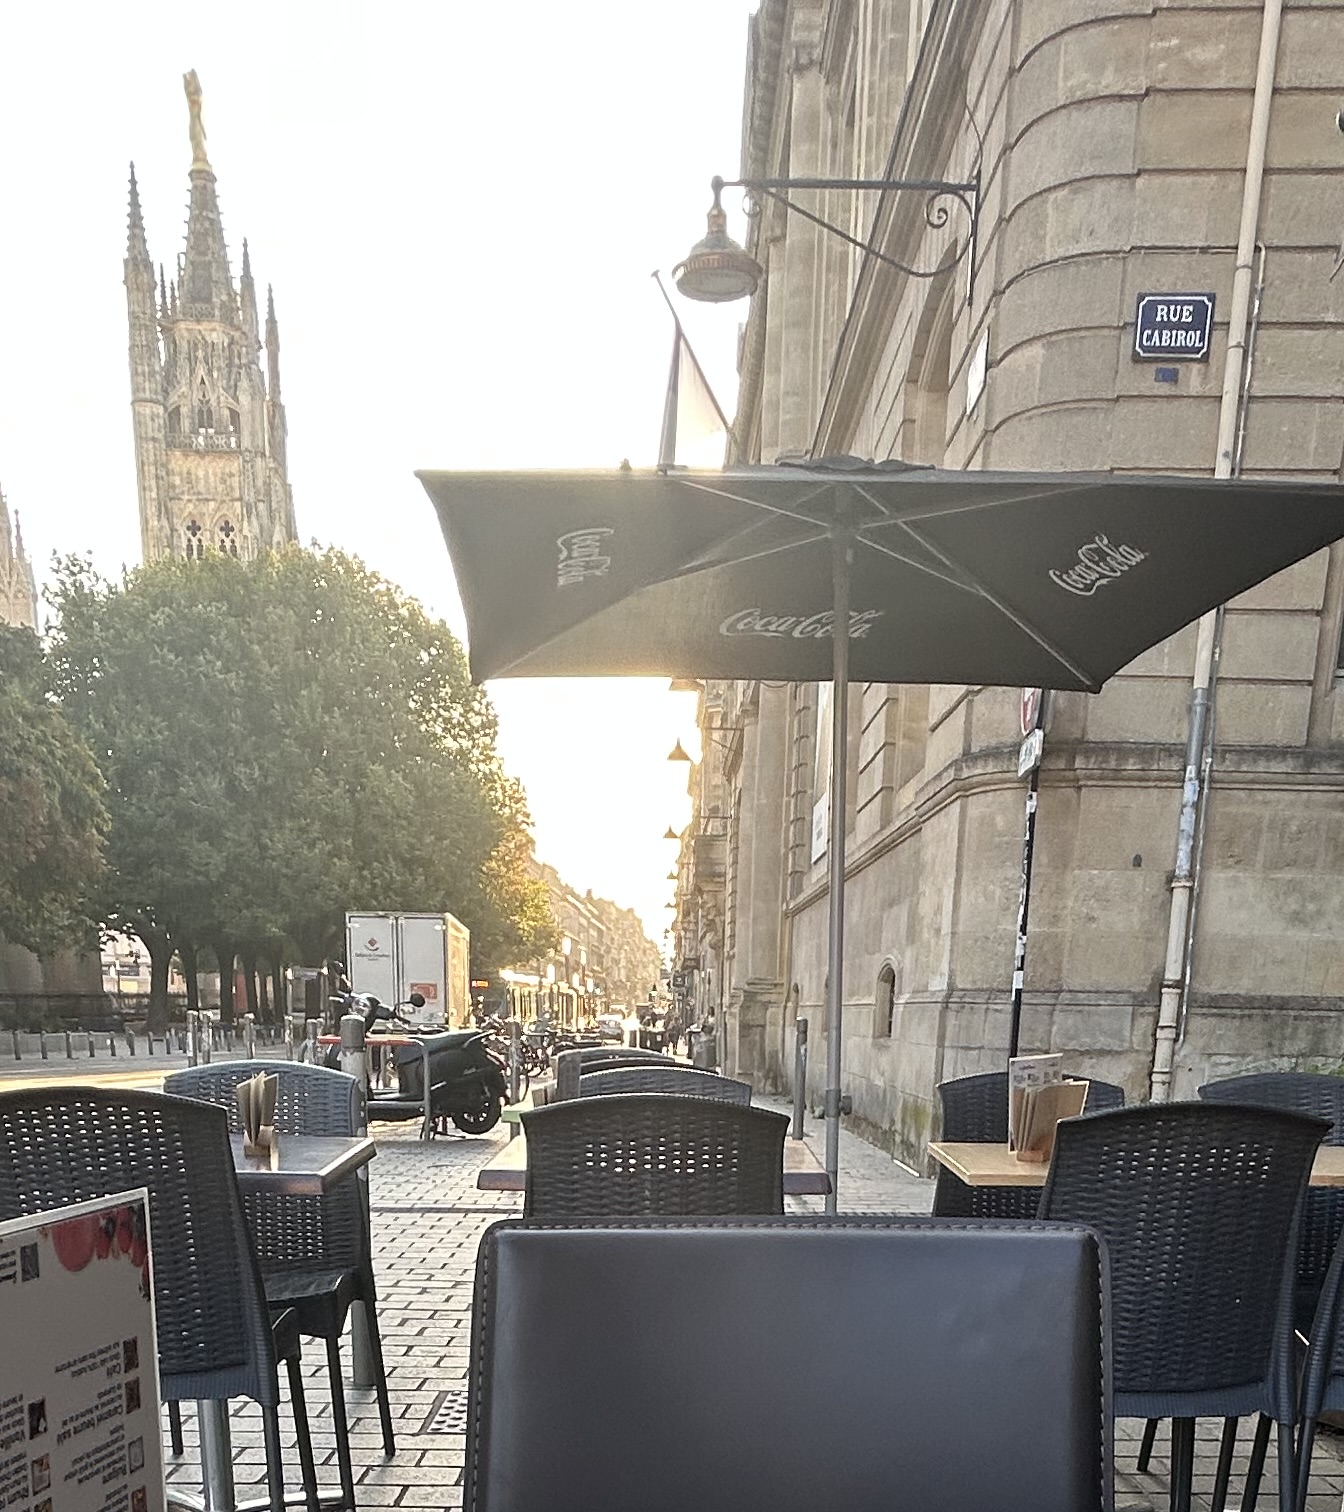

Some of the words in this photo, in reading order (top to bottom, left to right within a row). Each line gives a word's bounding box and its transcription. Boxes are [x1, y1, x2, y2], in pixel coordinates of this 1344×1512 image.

[1156, 305, 1193, 322] RUE
[1142, 329, 1203, 347] CABIROL
[1049, 533, 1149, 595] Coca-Cola
